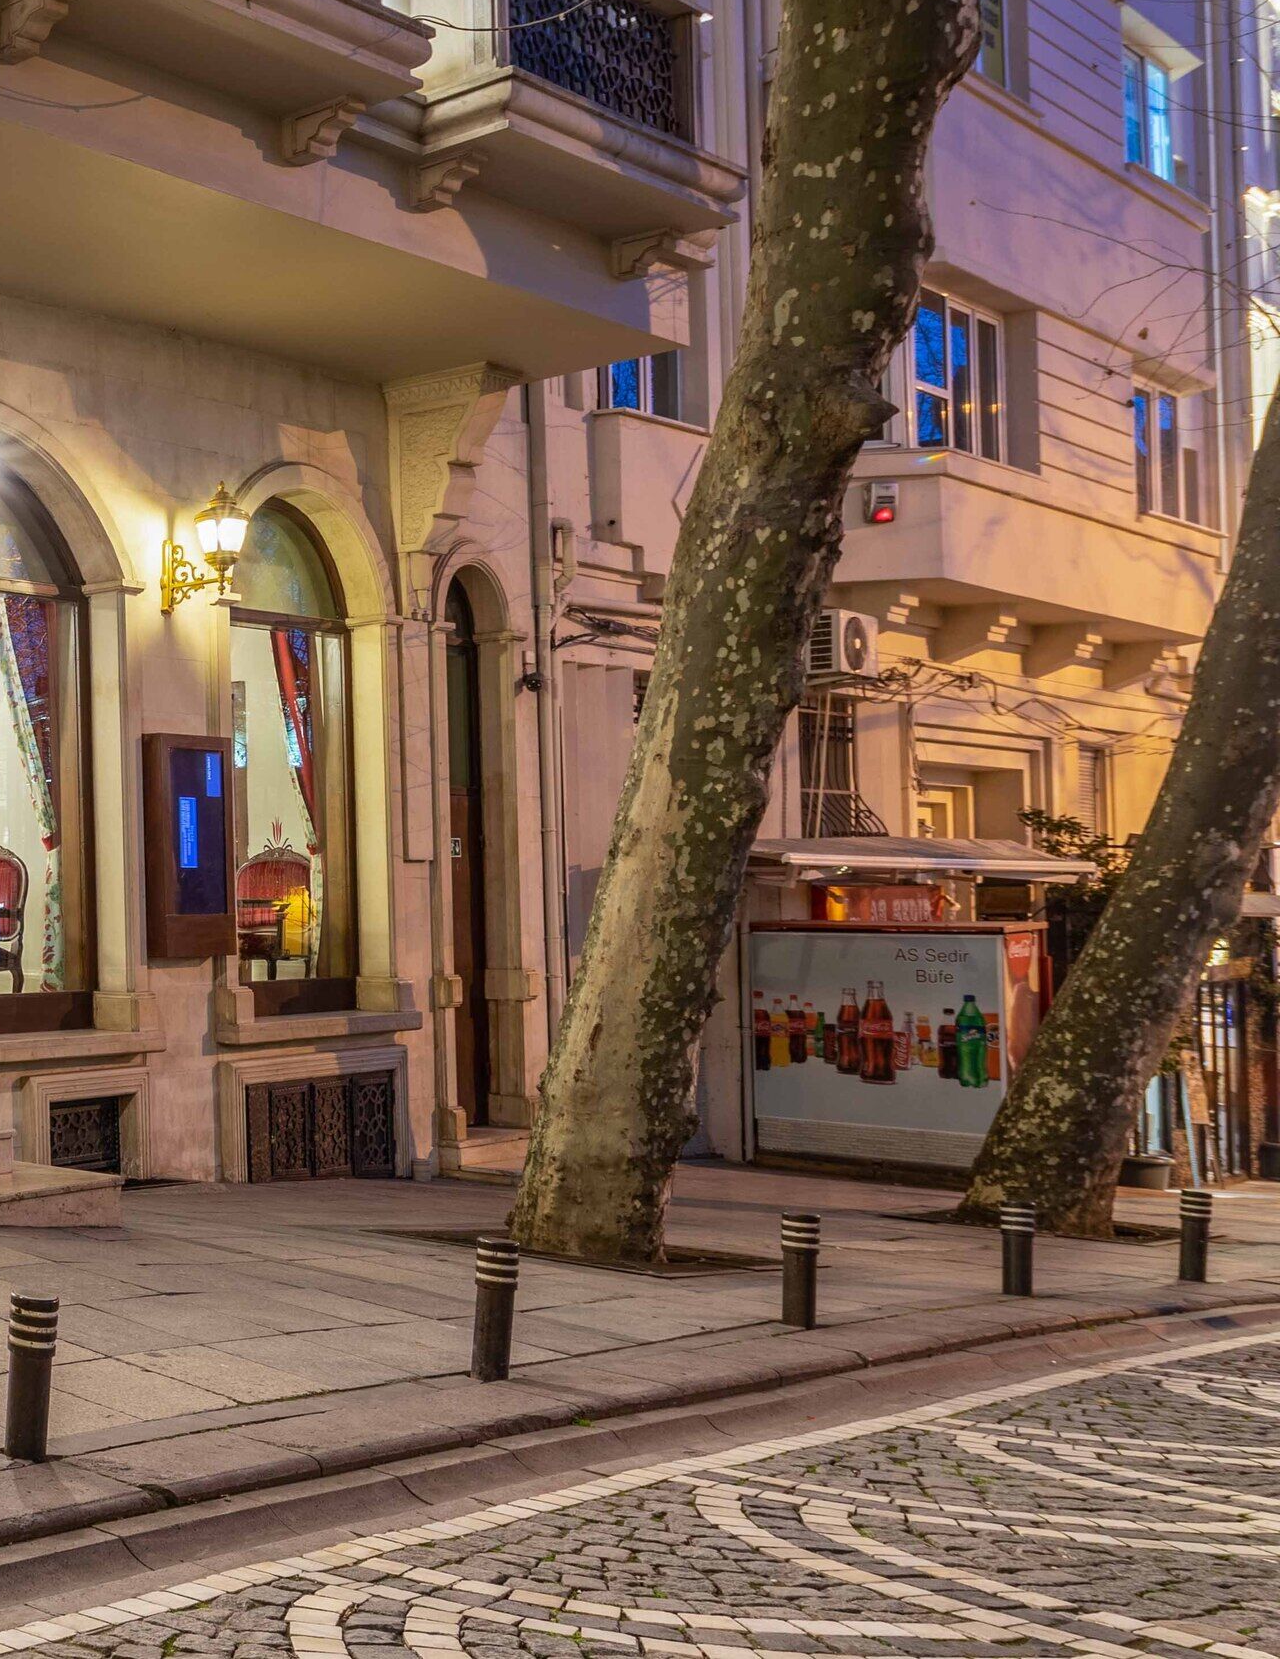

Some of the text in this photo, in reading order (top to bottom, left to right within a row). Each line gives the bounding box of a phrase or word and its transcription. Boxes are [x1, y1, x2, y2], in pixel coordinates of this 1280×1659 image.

[894, 948, 969, 963] AS Sedir
[915, 968, 954, 984] Büfe
